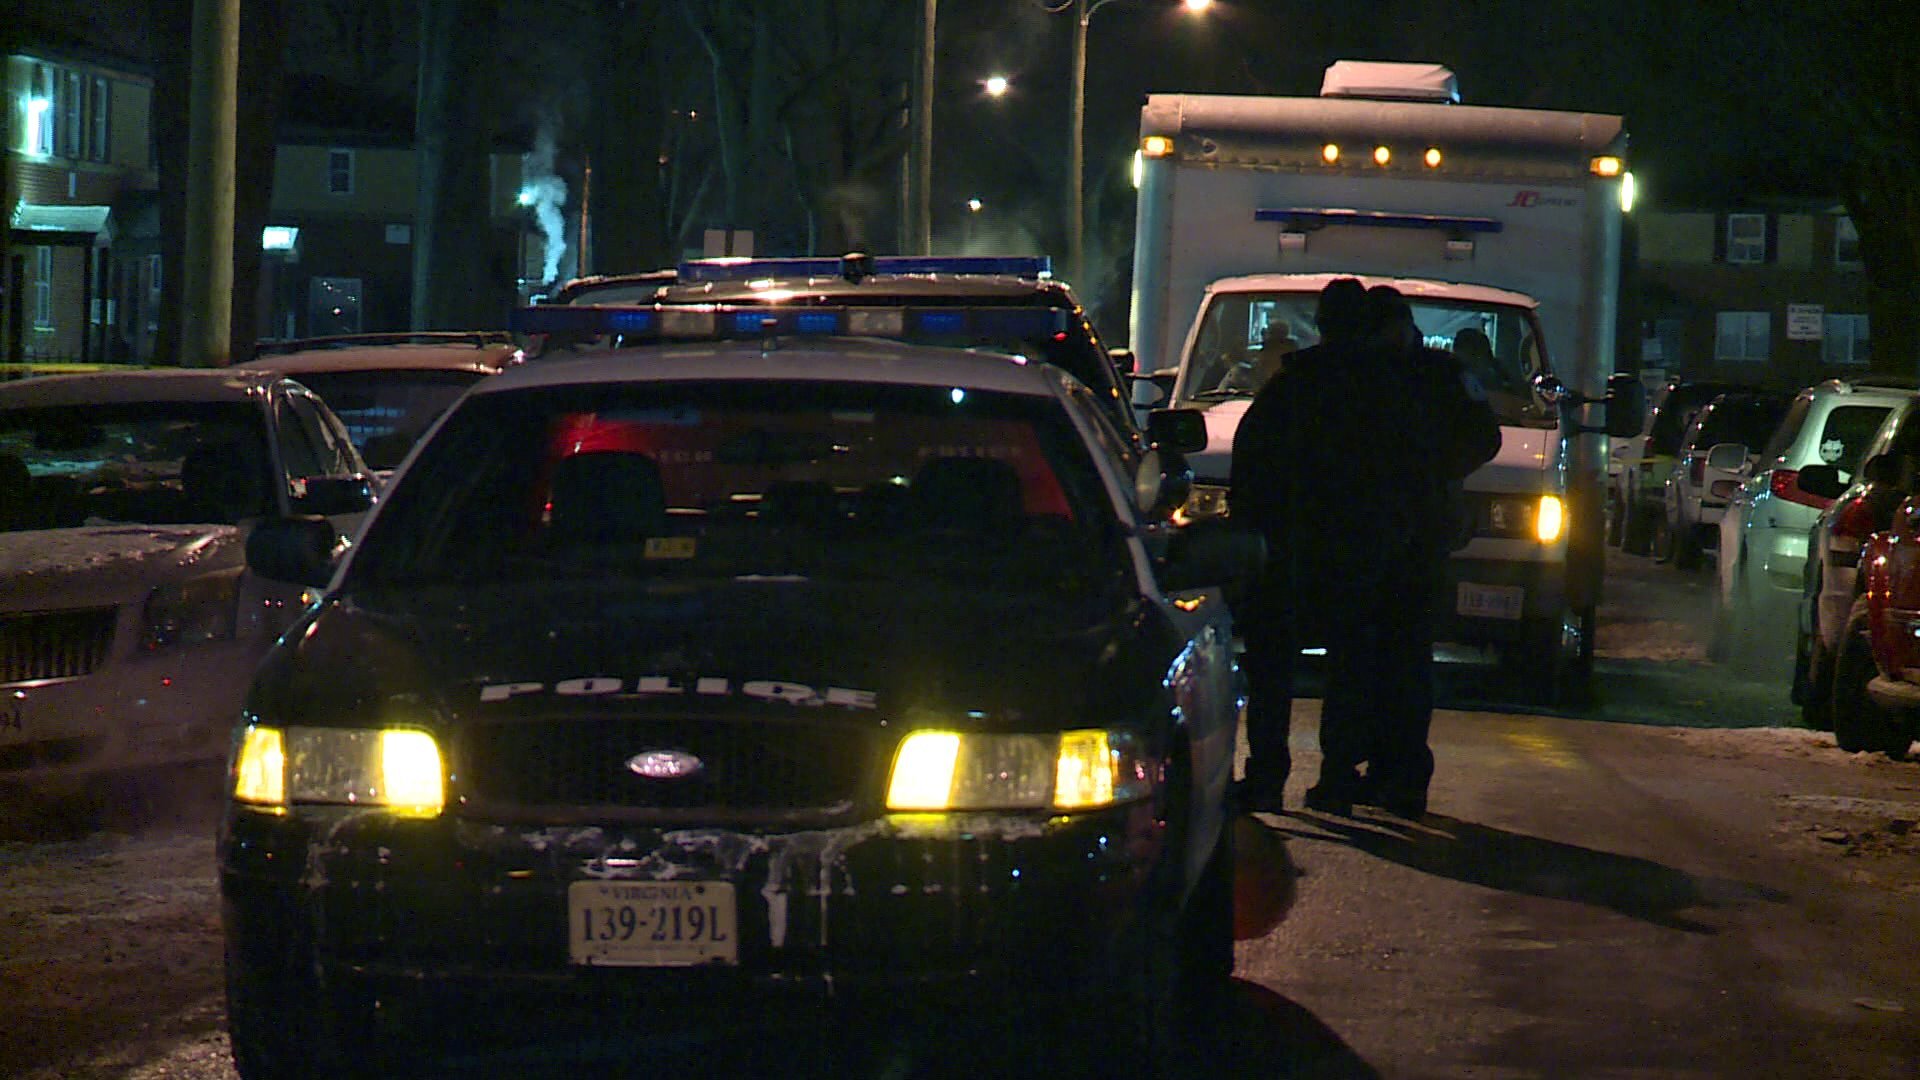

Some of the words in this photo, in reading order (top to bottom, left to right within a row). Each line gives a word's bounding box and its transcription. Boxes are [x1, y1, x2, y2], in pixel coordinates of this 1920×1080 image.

[479, 676, 877, 710] POLICE
[612, 886, 692, 900] VIRGINIA
[583, 905, 728, 942] 139-219L
